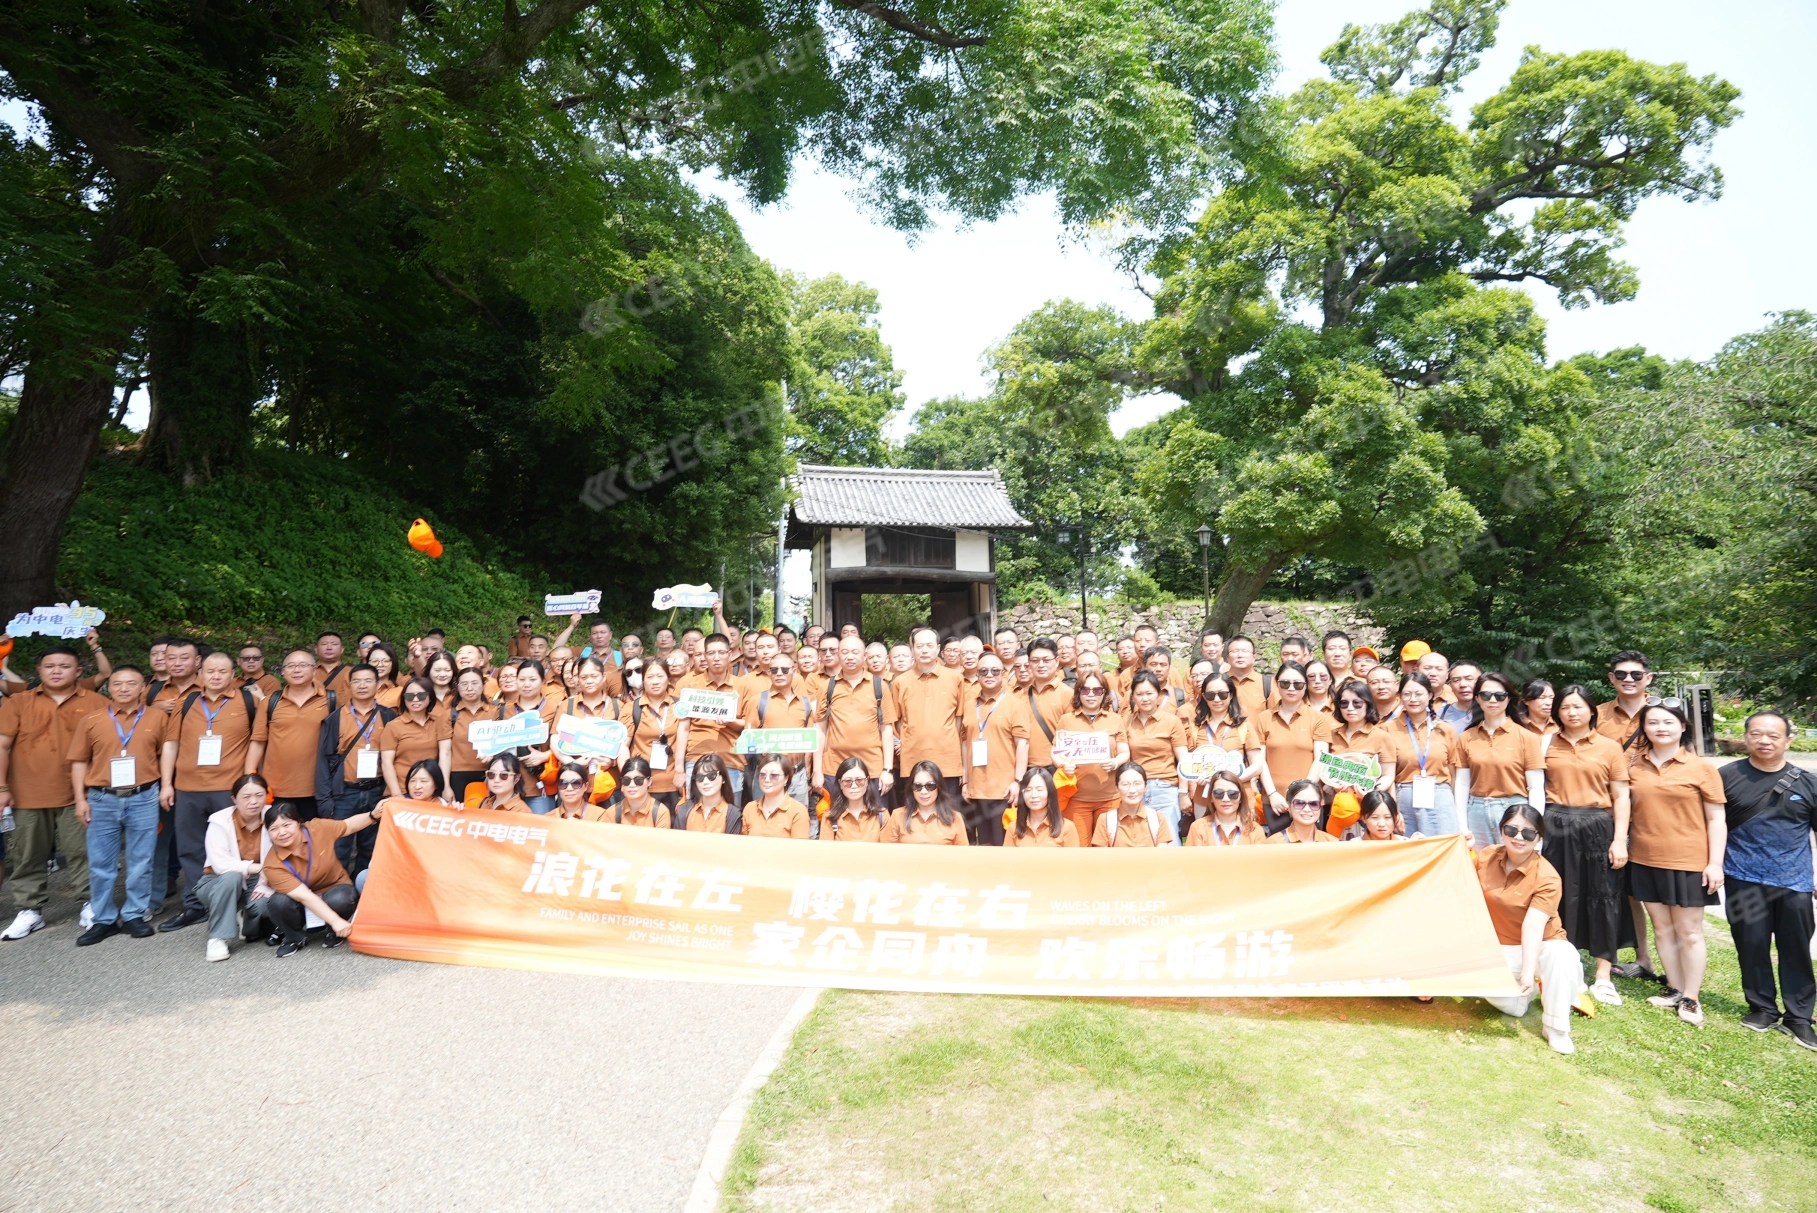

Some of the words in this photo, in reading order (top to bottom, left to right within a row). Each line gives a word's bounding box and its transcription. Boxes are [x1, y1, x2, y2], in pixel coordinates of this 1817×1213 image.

[16, 614, 63, 624] 为中电
[414, 814, 466, 837] CEEG
[466, 821, 549, 847] 中电电气
[521, 851, 749, 912] 浪花在左
[788, 875, 1032, 929] 樱花在右
[1050, 900, 1090, 911] WAVES
[1092, 900, 1111, 911] ON
[1113, 900, 1136, 911] THE
[1139, 900, 1168, 911] LEFT
[540, 907, 575, 921] FAMILY
[577, 912, 600, 923] AND
[602, 913, 666, 931] ENTERPRISE
[668, 920, 692, 933] SAIL
[694, 923, 708, 934] AS
[710, 924, 734, 937] ONE
[1050, 914, 1095, 926] CHERRY
[1099, 914, 1148, 926] BLOOMS
[1151, 914, 1169, 926] ON
[1172, 914, 1196, 926] THE
[626, 931, 647, 942] JOY
[648, 932, 689, 947] SHINES
[690, 935, 733, 950] BRIGHT
[746, 921, 988, 976] 家企同舟
[1034, 930, 1294, 980] 欢乐畅游
